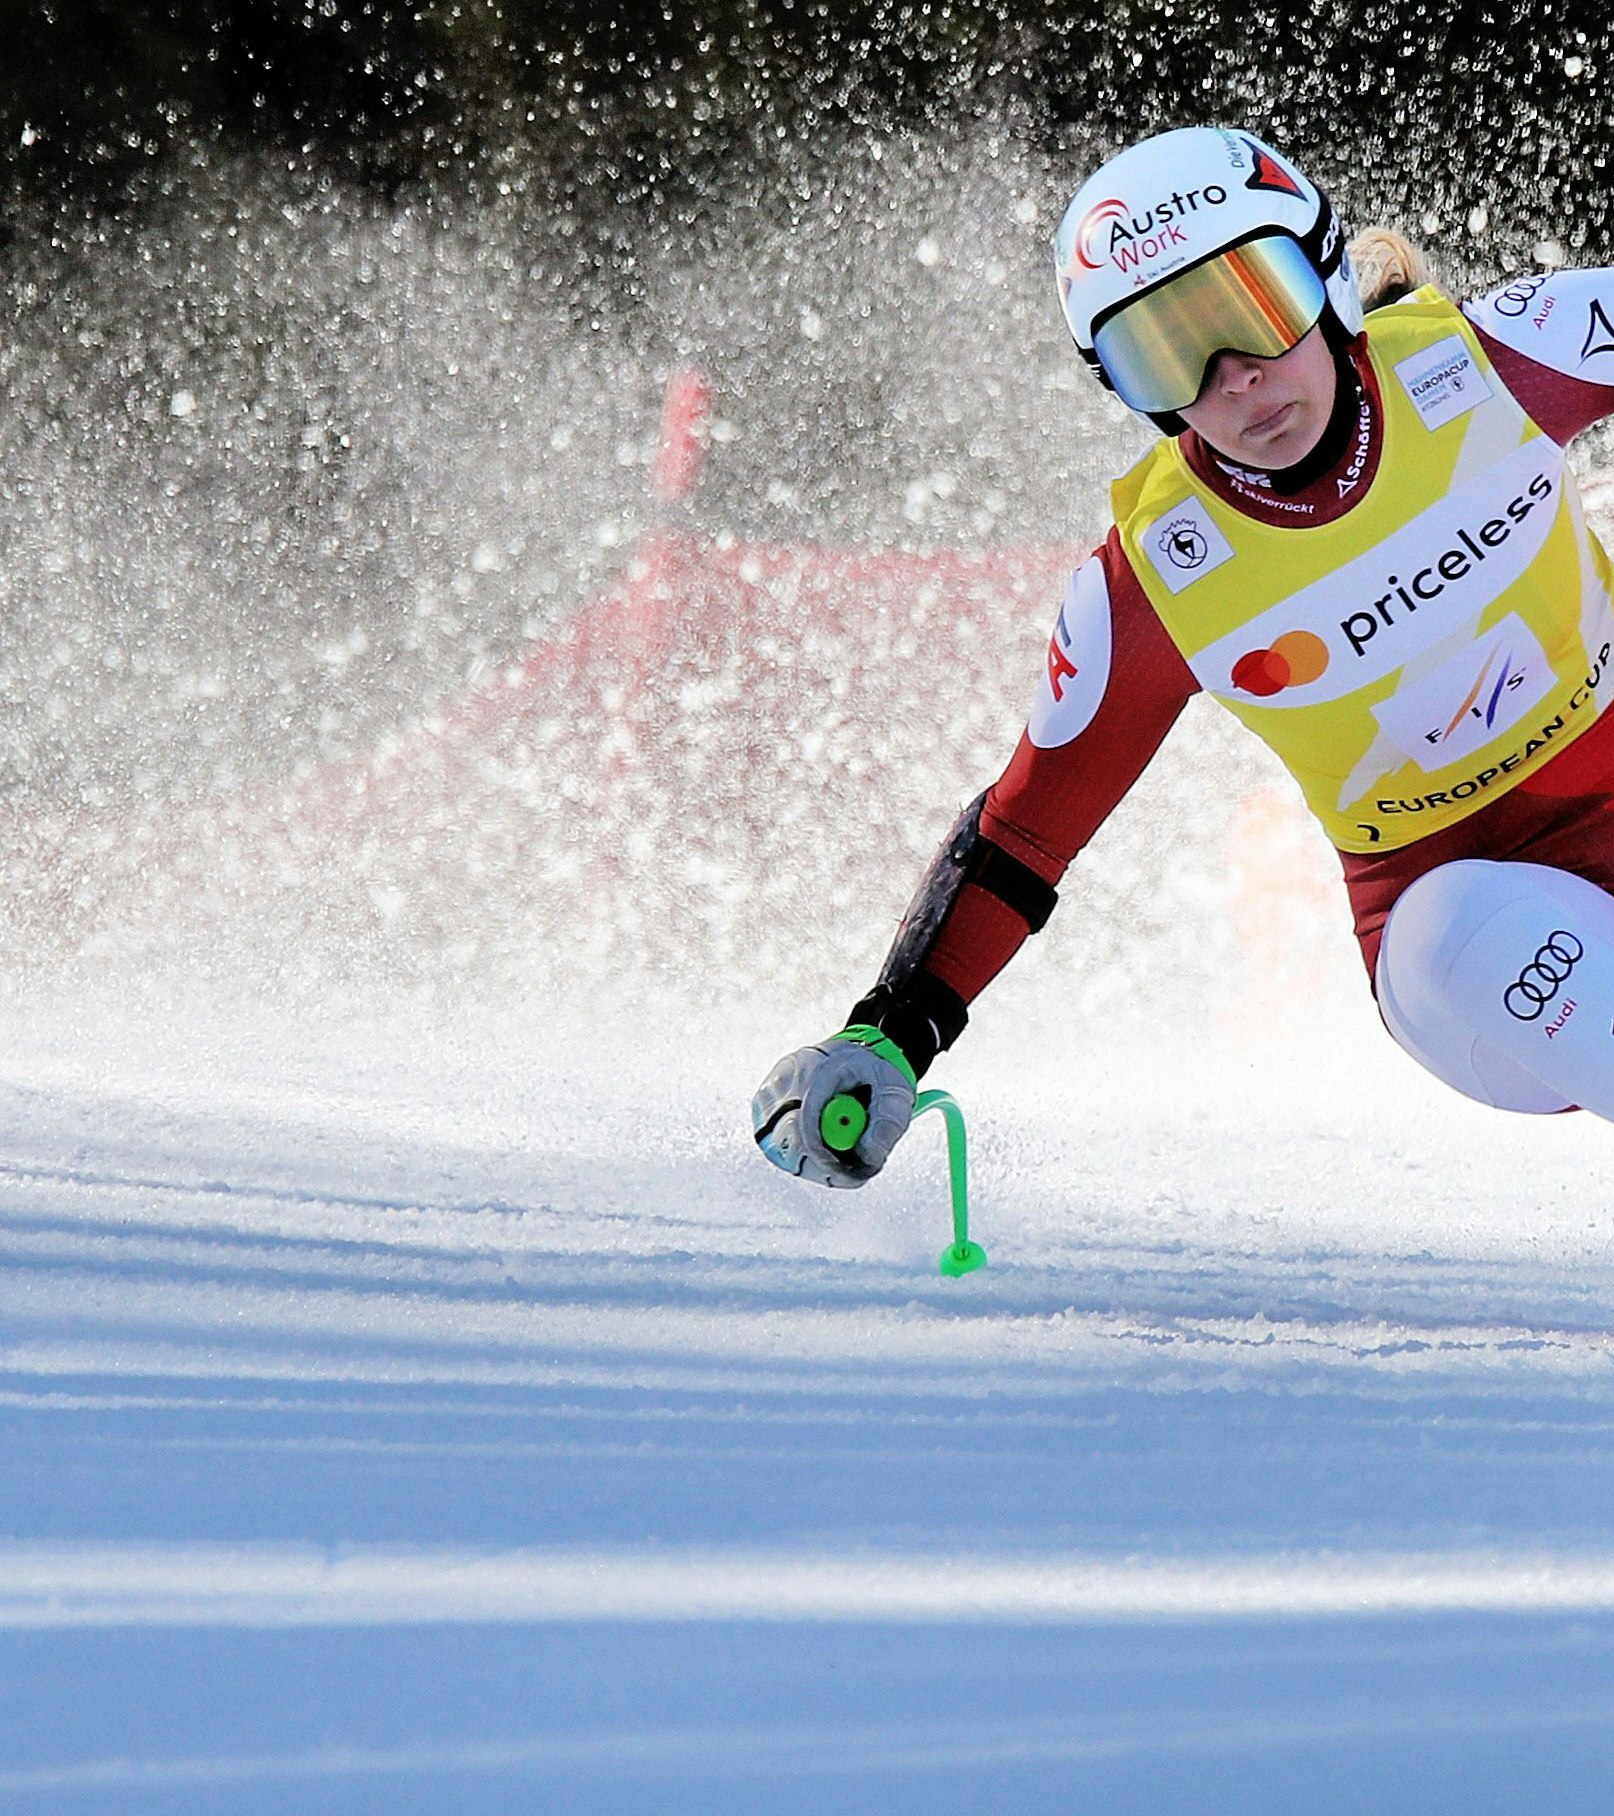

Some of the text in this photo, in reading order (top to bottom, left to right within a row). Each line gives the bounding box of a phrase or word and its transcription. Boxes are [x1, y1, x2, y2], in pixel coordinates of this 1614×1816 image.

[1110, 185, 1227, 253] Austro
[1112, 224, 1188, 273] Work
[1533, 295, 1556, 331] Audi
[1411, 359, 1469, 397] EUROPACUP
[1340, 473, 1552, 657] priceless
[1377, 641, 1611, 814] EUROPEAN CUP
[1544, 998, 1578, 1040] Audi
